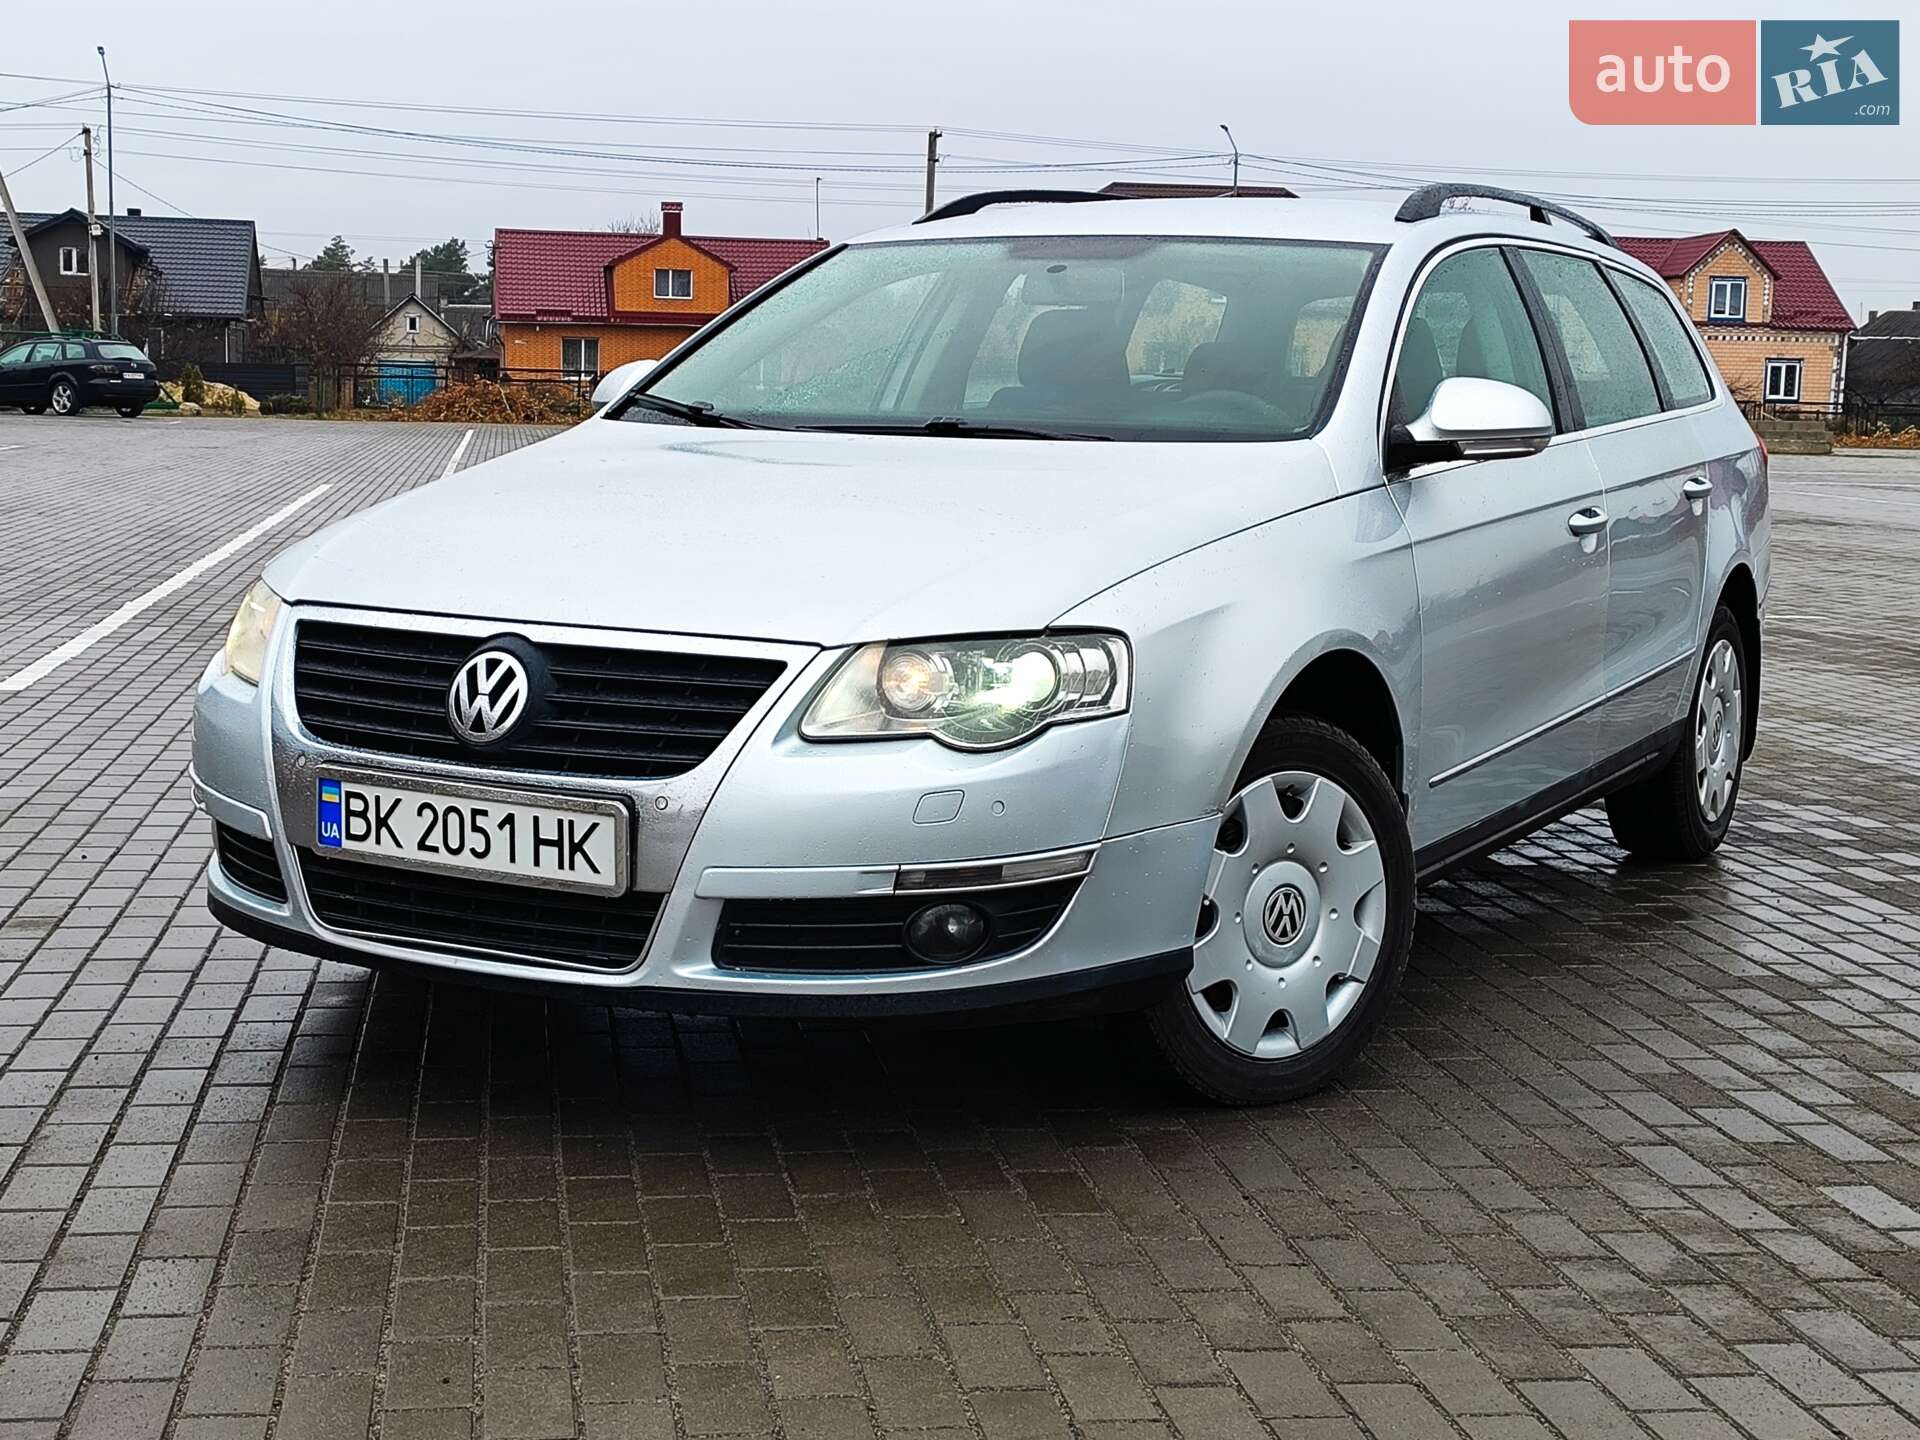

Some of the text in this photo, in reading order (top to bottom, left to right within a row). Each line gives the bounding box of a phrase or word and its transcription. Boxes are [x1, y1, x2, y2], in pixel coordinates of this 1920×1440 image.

[449, 651, 528, 741] VW
[321, 820, 340, 839] UA
[344, 790, 601, 875] BK 2051 HK
